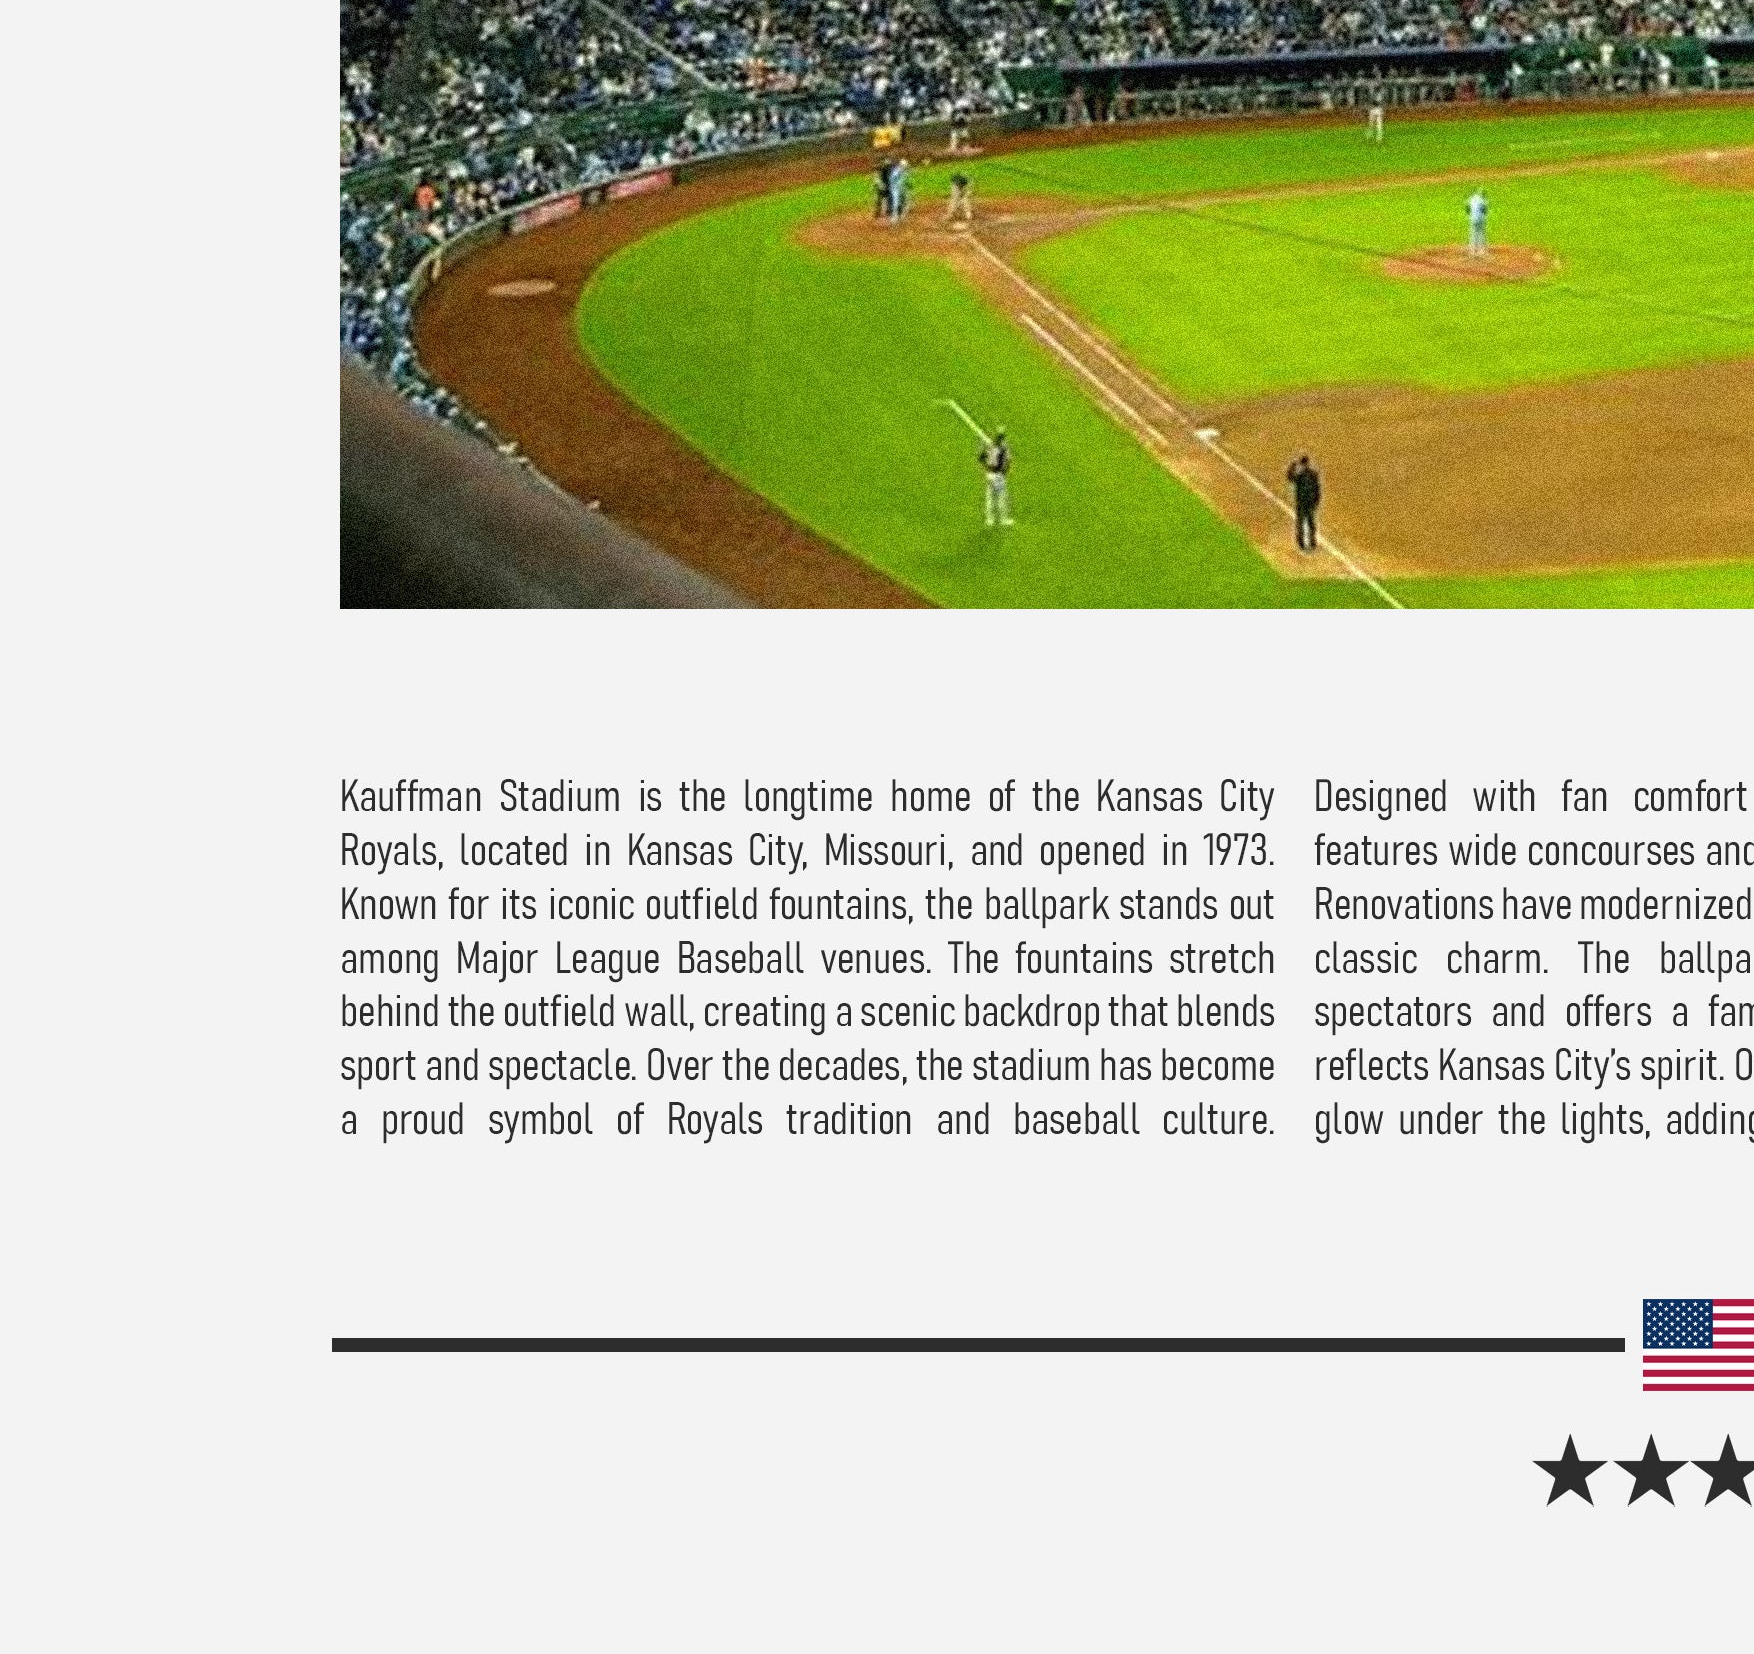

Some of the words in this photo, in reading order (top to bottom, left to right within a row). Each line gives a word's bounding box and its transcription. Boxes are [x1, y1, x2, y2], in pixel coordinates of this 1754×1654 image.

[341, 778, 481, 812] Kauffman
[500, 778, 620, 812] Stadium
[640, 779, 662, 812] is
[679, 778, 726, 812] the
[744, 778, 873, 821] longtime
[891, 778, 971, 812] home
[989, 778, 1016, 812] of
[1032, 778, 1080, 812] the
[1097, 778, 1203, 812] Kansas
[1220, 778, 1275, 822] City
[1315, 778, 1447, 821] Designed
[1472, 778, 1535, 812] with
[1561, 778, 1607, 812] fan
[1634, 778, 1748, 812] comfort
[341, 832, 444, 876] Royals,
[460, 832, 568, 866] located
[586, 833, 610, 866] in
[628, 832, 733, 866] Kansas
[749, 832, 808, 876] City,
[825, 832, 954, 872] Missouri,
[971, 832, 1023, 867] and
[1040, 832, 1145, 875] opened
[1163, 833, 1187, 866] in
[1203, 832, 1275, 866] 1973.
[1314, 832, 1438, 866] features
[1448, 832, 1517, 866] wide
[1528, 841, 1695, 866] concourses
[341, 949, 439, 983] among
[457, 940, 539, 984] Major
[556, 940, 660, 983] League
[678, 940, 805, 974] Baseball
[820, 949, 932, 974] venues.
[947, 940, 999, 974] The
[1015, 940, 1153, 974] fountains
[1169, 940, 1274, 974] stretch
[1315, 940, 1418, 974] classic
[1447, 940, 1549, 974] charm.
[1577, 940, 1630, 974] The
[340, 1050, 417, 1090] sport
[426, 1047, 479, 1082] and
[488, 1047, 637, 1090] spectacle.
[647, 1047, 714, 1081] Over
[721, 1047, 770, 1081] the
[779, 1047, 908, 1087] decades,
[916, 1047, 963, 1081] the
[972, 1047, 1090, 1081] stadium
[1100, 1047, 1152, 1081] has
[1161, 1047, 1275, 1081] become
[1315, 1047, 1429, 1081] reflects
[1439, 1047, 1545, 1081] Kansas
[1555, 1047, 1631, 1091] City’s
[1640, 1048, 1725, 1090] spirit.
[341, 1110, 357, 1135] a
[382, 1101, 464, 1144] proud
[488, 1101, 594, 1145] symbol
[617, 1101, 645, 1135] of
[668, 1101, 763, 1145] Royals
[786, 1101, 911, 1135] tradition
[937, 1101, 990, 1135] and
[1014, 1101, 1141, 1135] baseball
[1163, 1101, 1275, 1135] culture.
[1315, 1101, 1384, 1144] glow
[1399, 1101, 1484, 1135] under
[1498, 1101, 1546, 1135] the
[1561, 1101, 1651, 1144] lights,
